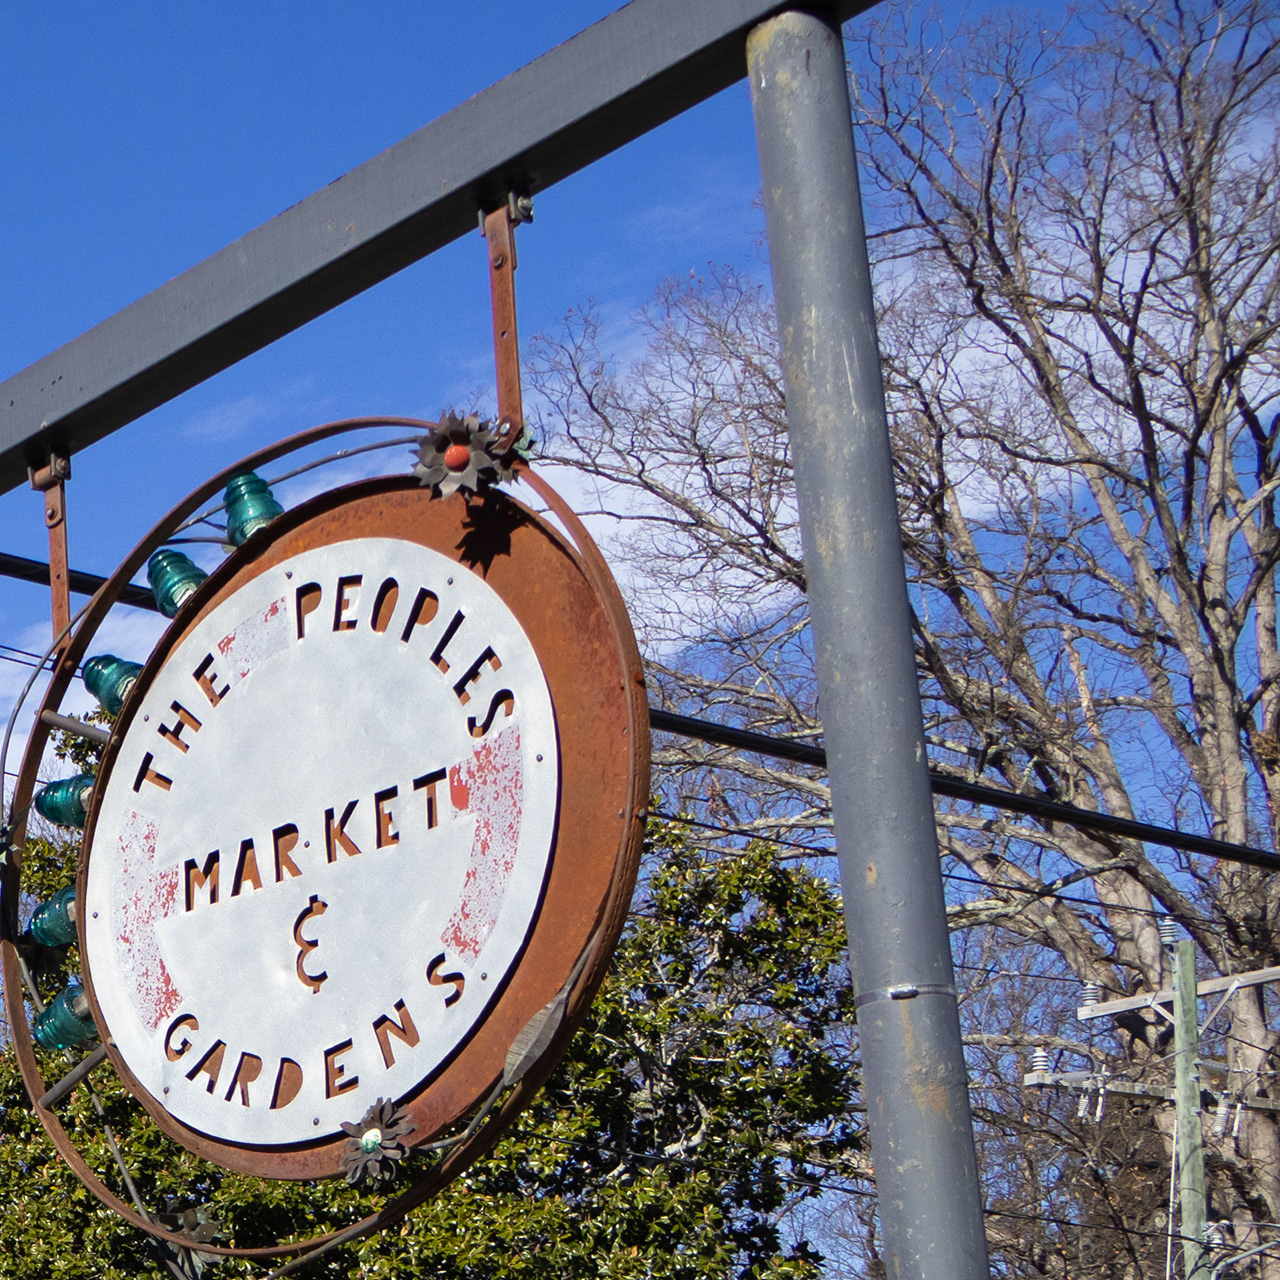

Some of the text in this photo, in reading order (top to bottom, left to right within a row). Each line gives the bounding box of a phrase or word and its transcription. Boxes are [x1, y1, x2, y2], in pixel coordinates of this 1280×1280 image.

[132, 574, 515, 795] THE PEOPLES
[184, 767, 448, 914] MARKET
[163, 952, 466, 1110] GARDENS
